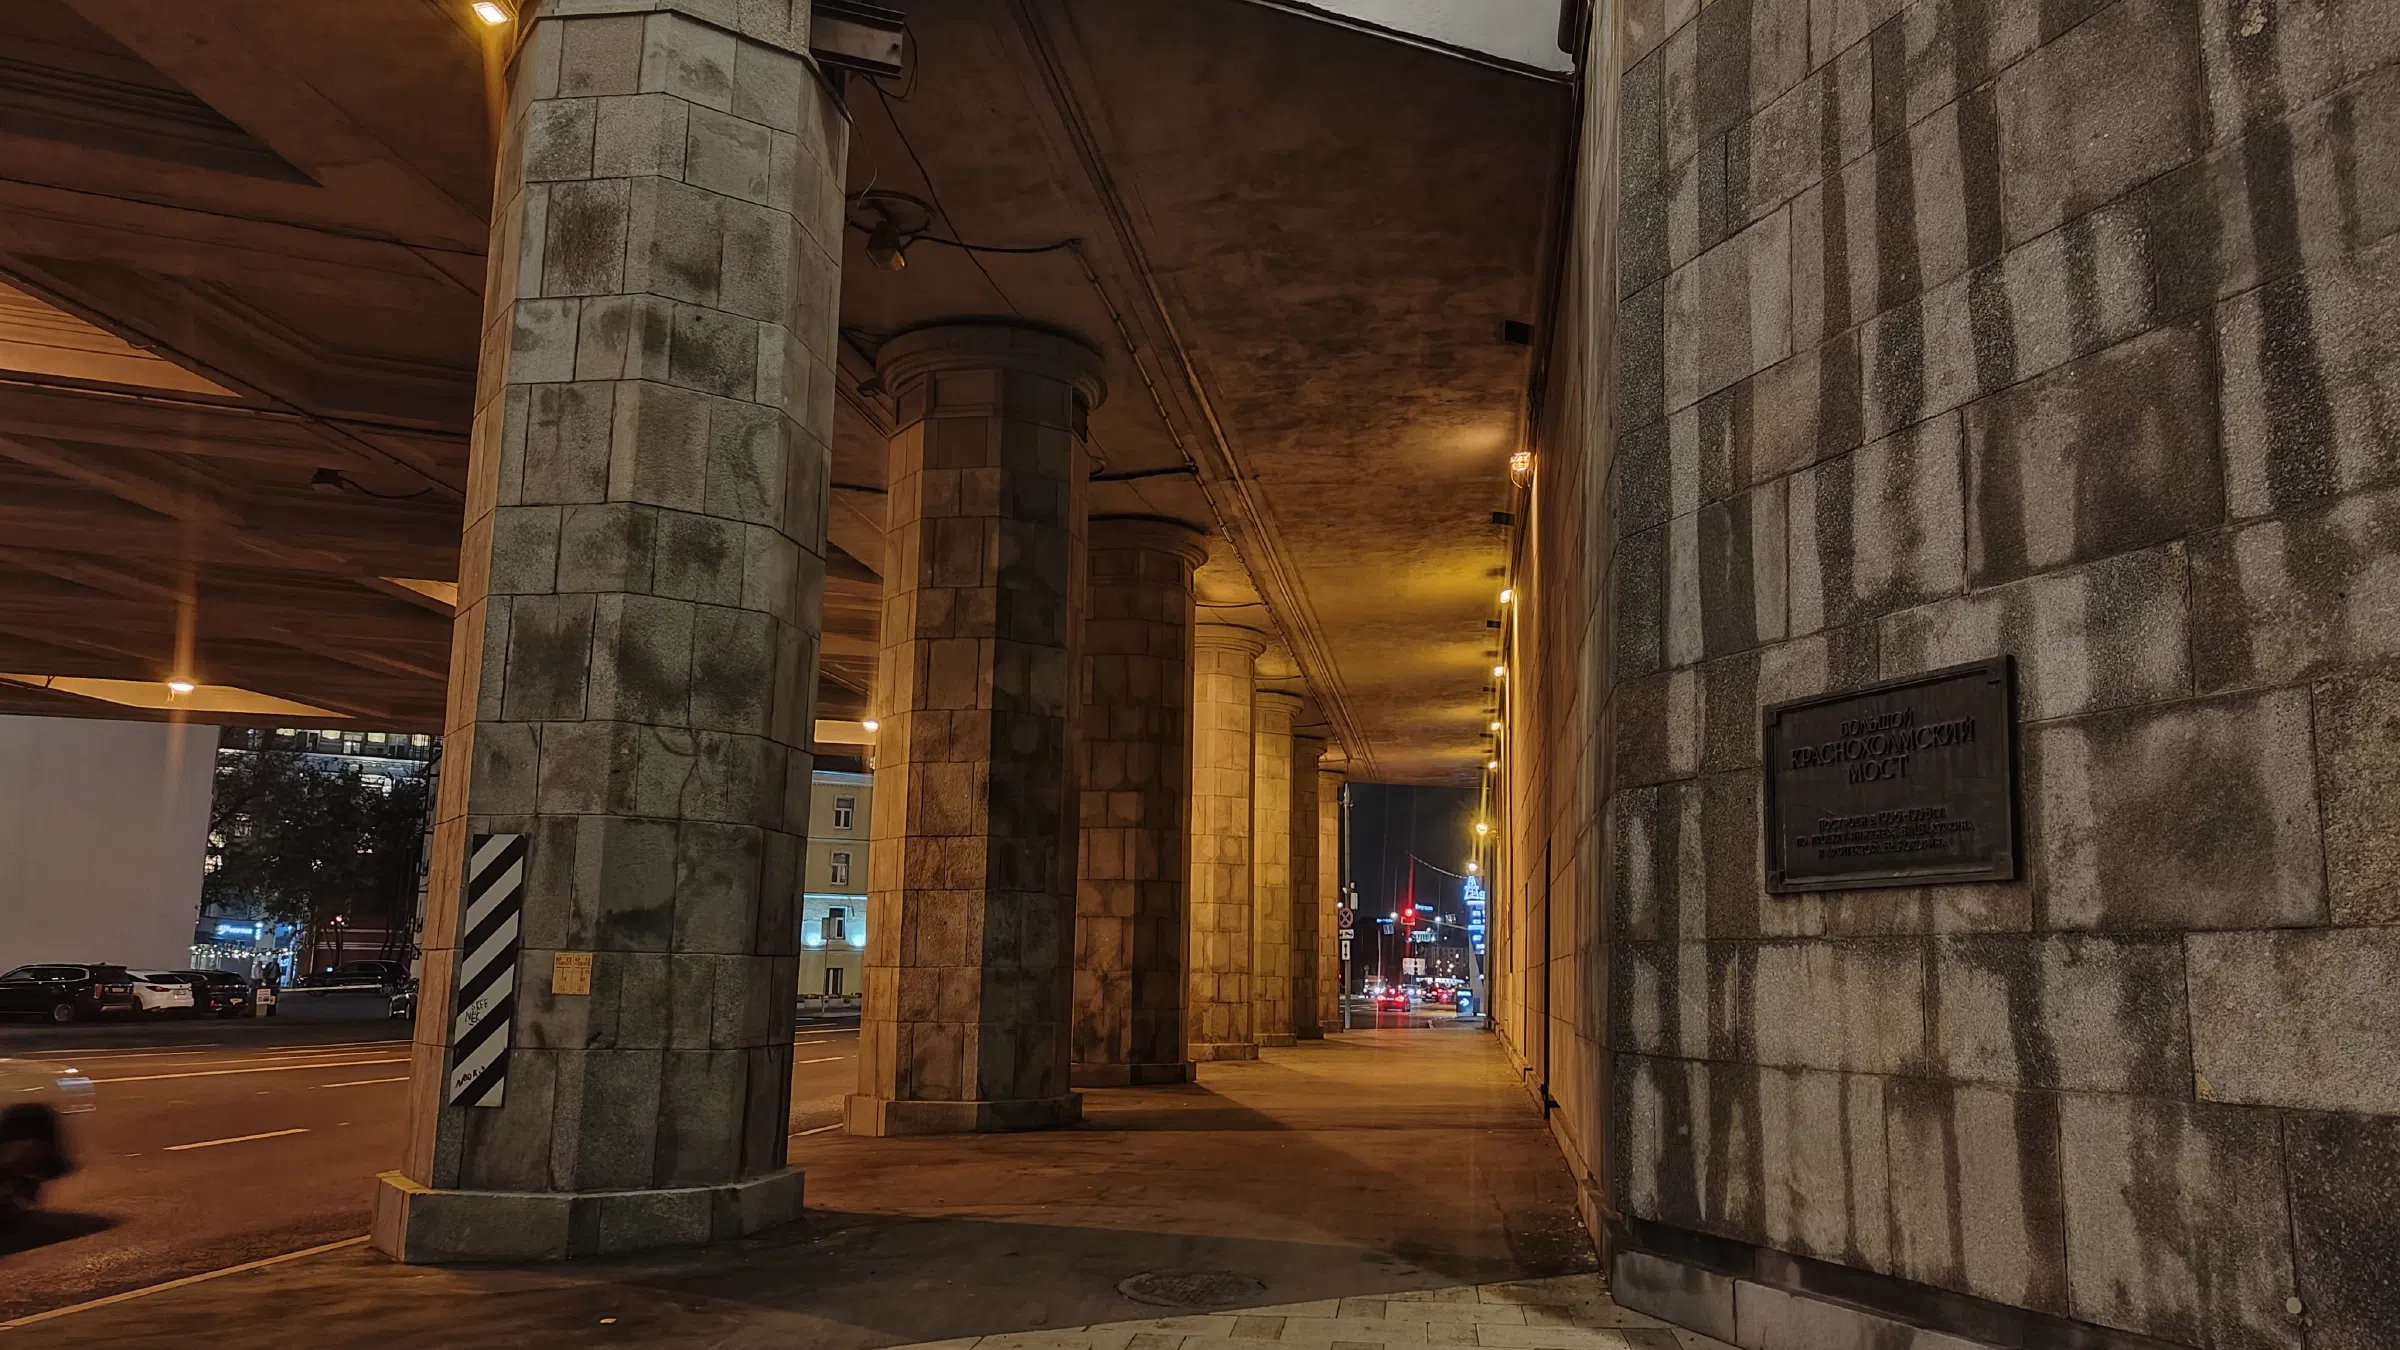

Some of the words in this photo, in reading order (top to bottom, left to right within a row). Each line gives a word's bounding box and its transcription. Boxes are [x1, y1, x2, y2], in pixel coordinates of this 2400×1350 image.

[1840, 706, 1915, 737] БОЛЬШОЙ
[1790, 715, 1977, 770] КРАСНОХОЛМСКИЙ
[1848, 755, 1911, 785] МОСТ
